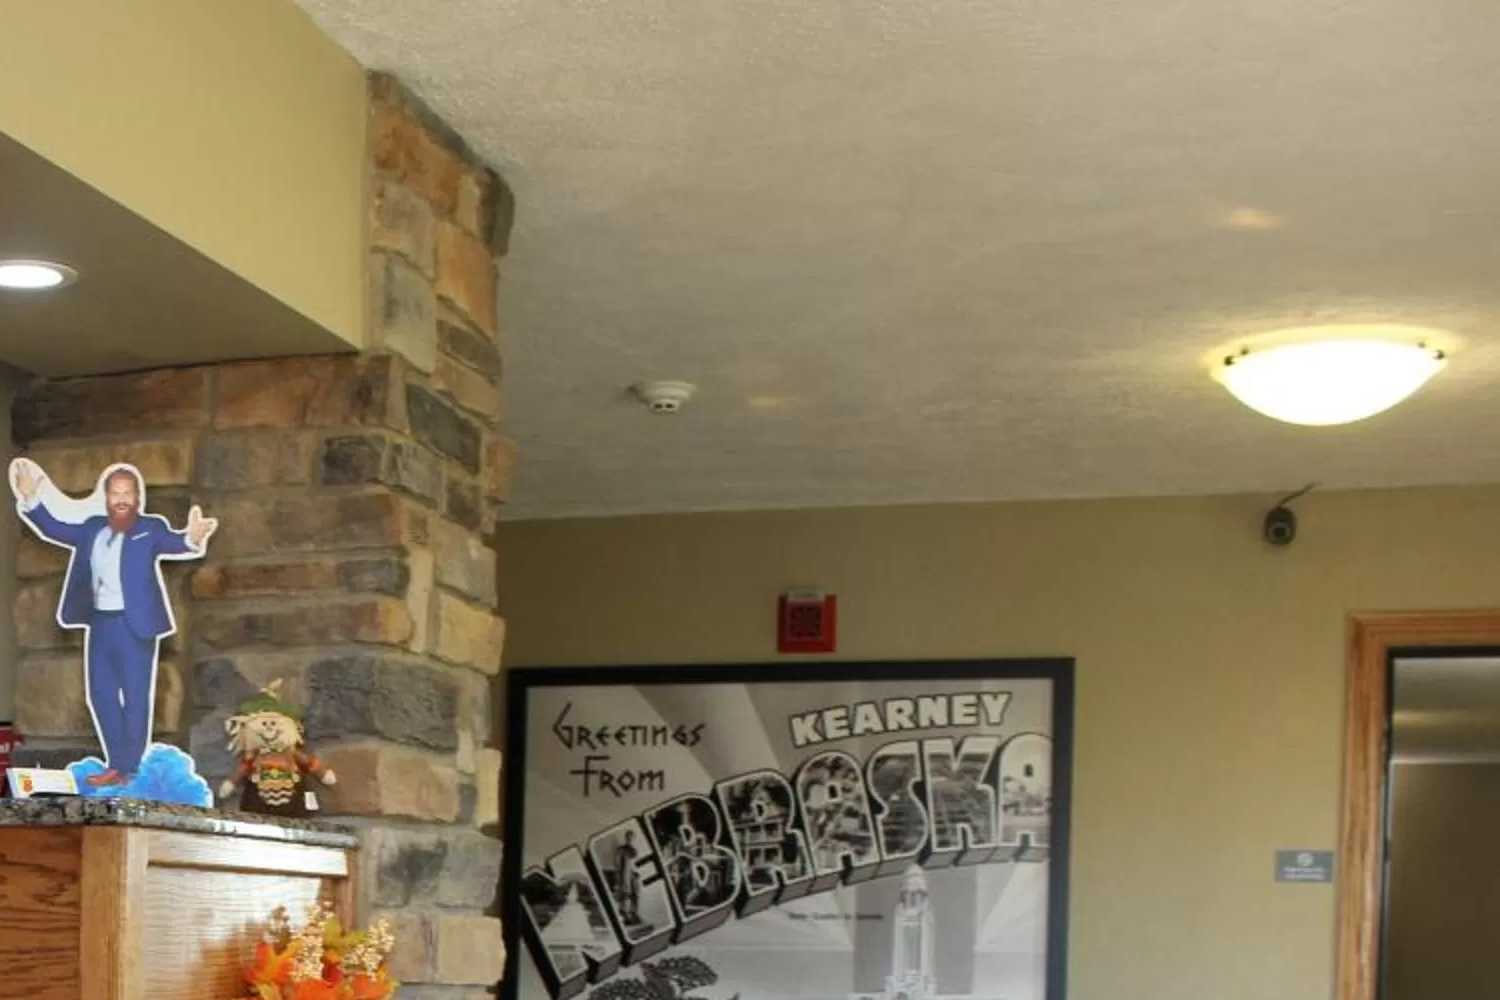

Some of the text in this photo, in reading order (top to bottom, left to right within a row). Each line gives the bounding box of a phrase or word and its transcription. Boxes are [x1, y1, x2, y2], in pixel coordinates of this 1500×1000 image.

[552, 702, 707, 751] GREETINGS
[789, 692, 1013, 747] KEARNEY
[569, 755, 665, 798] FROM
